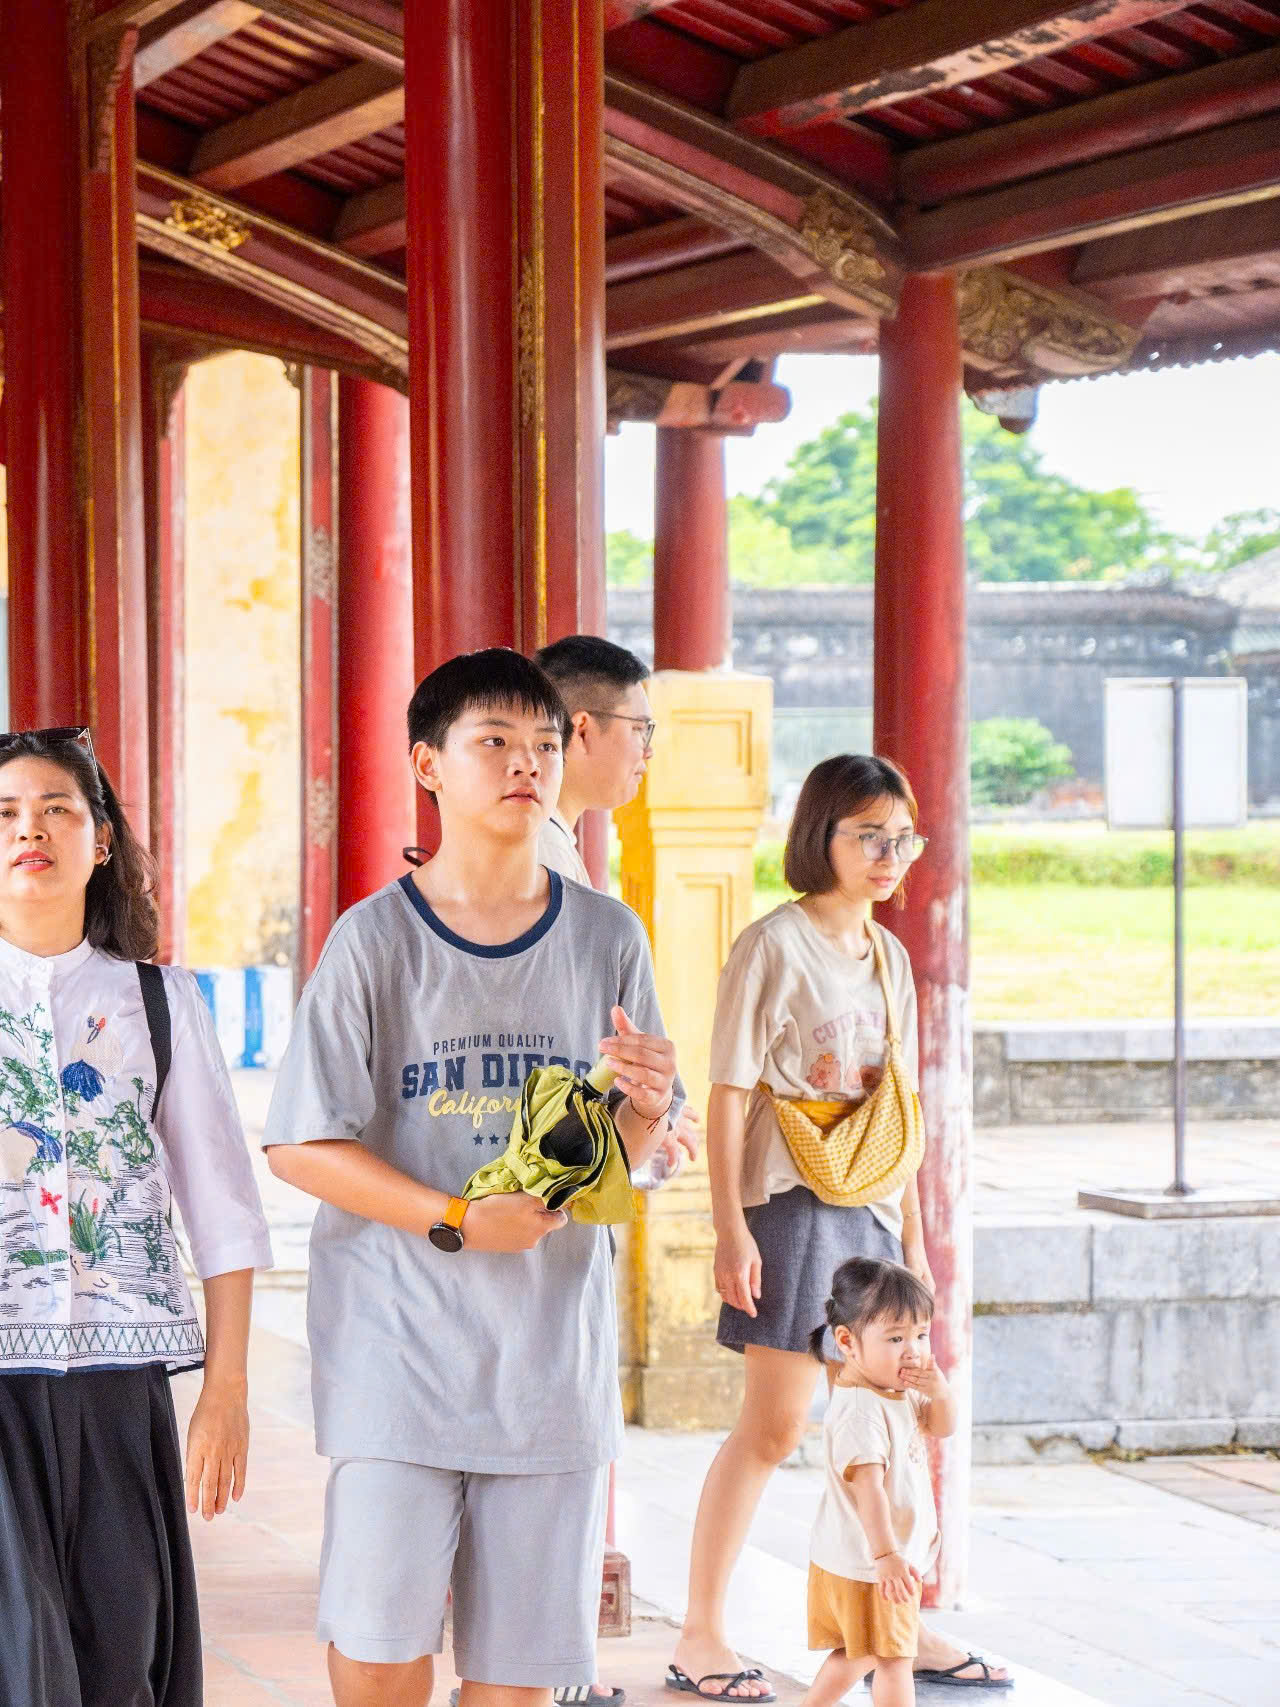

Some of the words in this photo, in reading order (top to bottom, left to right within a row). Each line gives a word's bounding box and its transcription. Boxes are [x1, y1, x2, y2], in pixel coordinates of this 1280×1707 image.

[433, 1034, 492, 1055] PREMIUM
[498, 1034, 555, 1049] QUALITY
[402, 1055, 466, 1099] SAN
